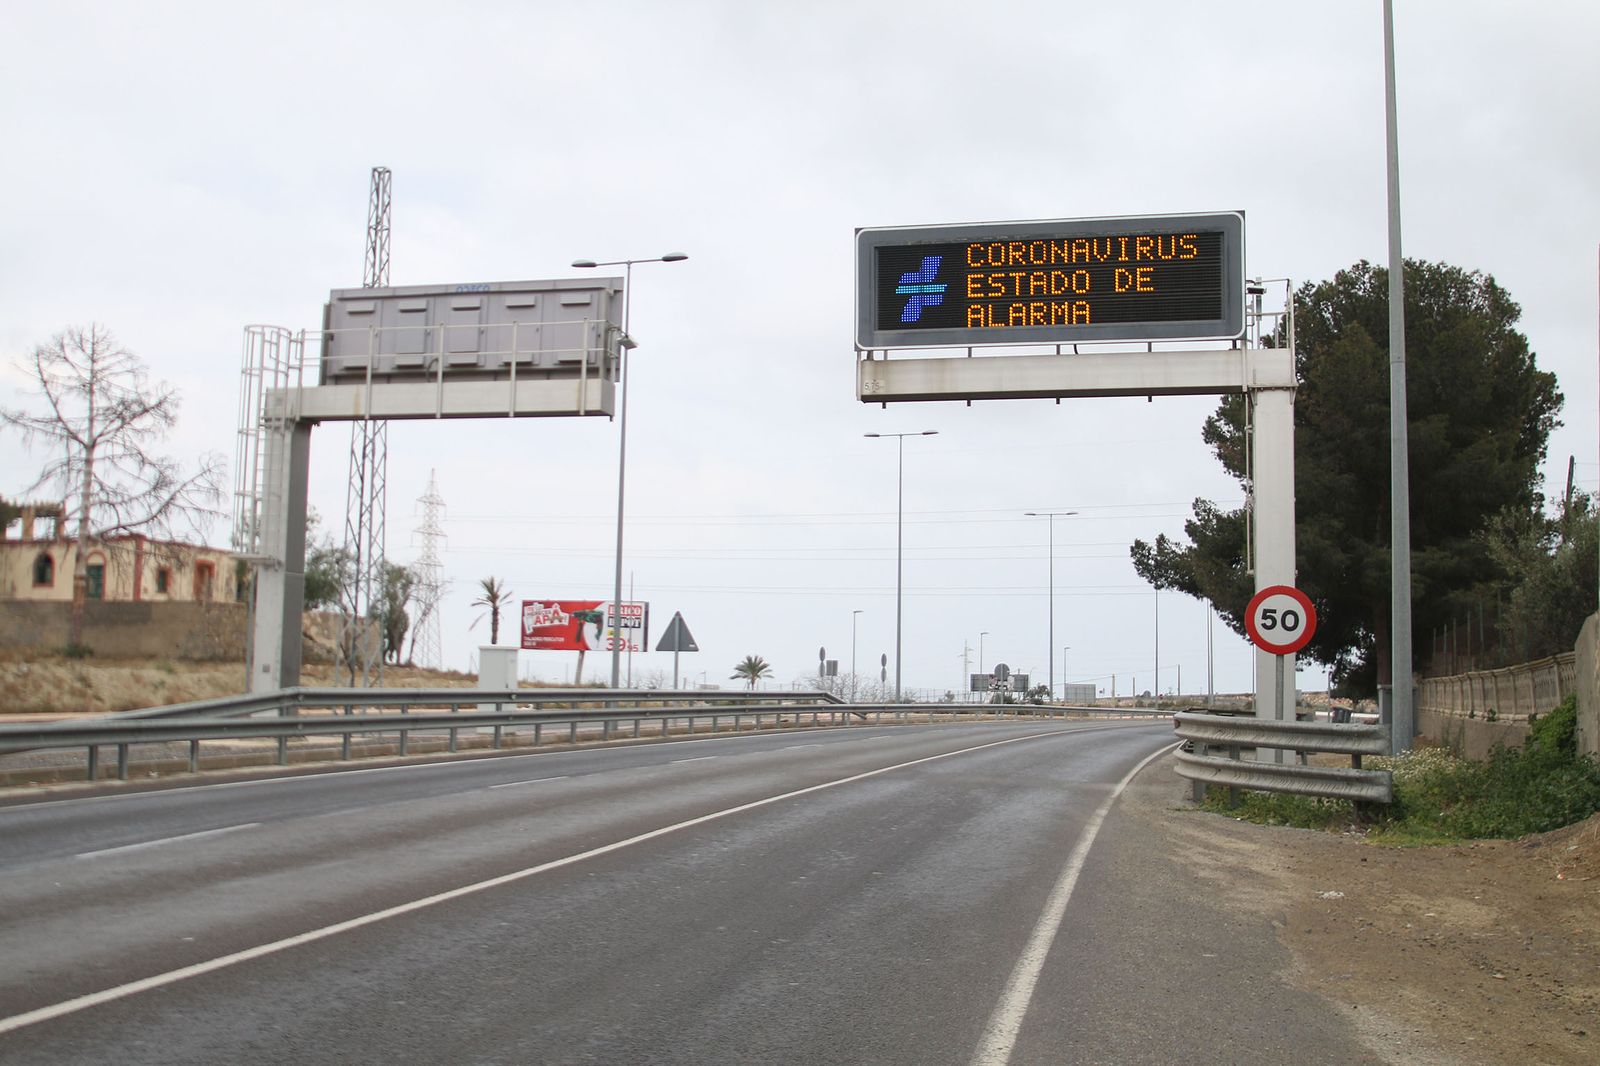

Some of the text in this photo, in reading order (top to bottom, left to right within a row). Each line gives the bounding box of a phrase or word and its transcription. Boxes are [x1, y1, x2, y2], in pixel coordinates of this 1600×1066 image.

[967, 234, 1198, 268] CORONAVIRUS
[967, 267, 1154, 298] ESTADO DE
[967, 300, 1090, 329] ALARMA
[1260, 608, 1300, 632] 50
